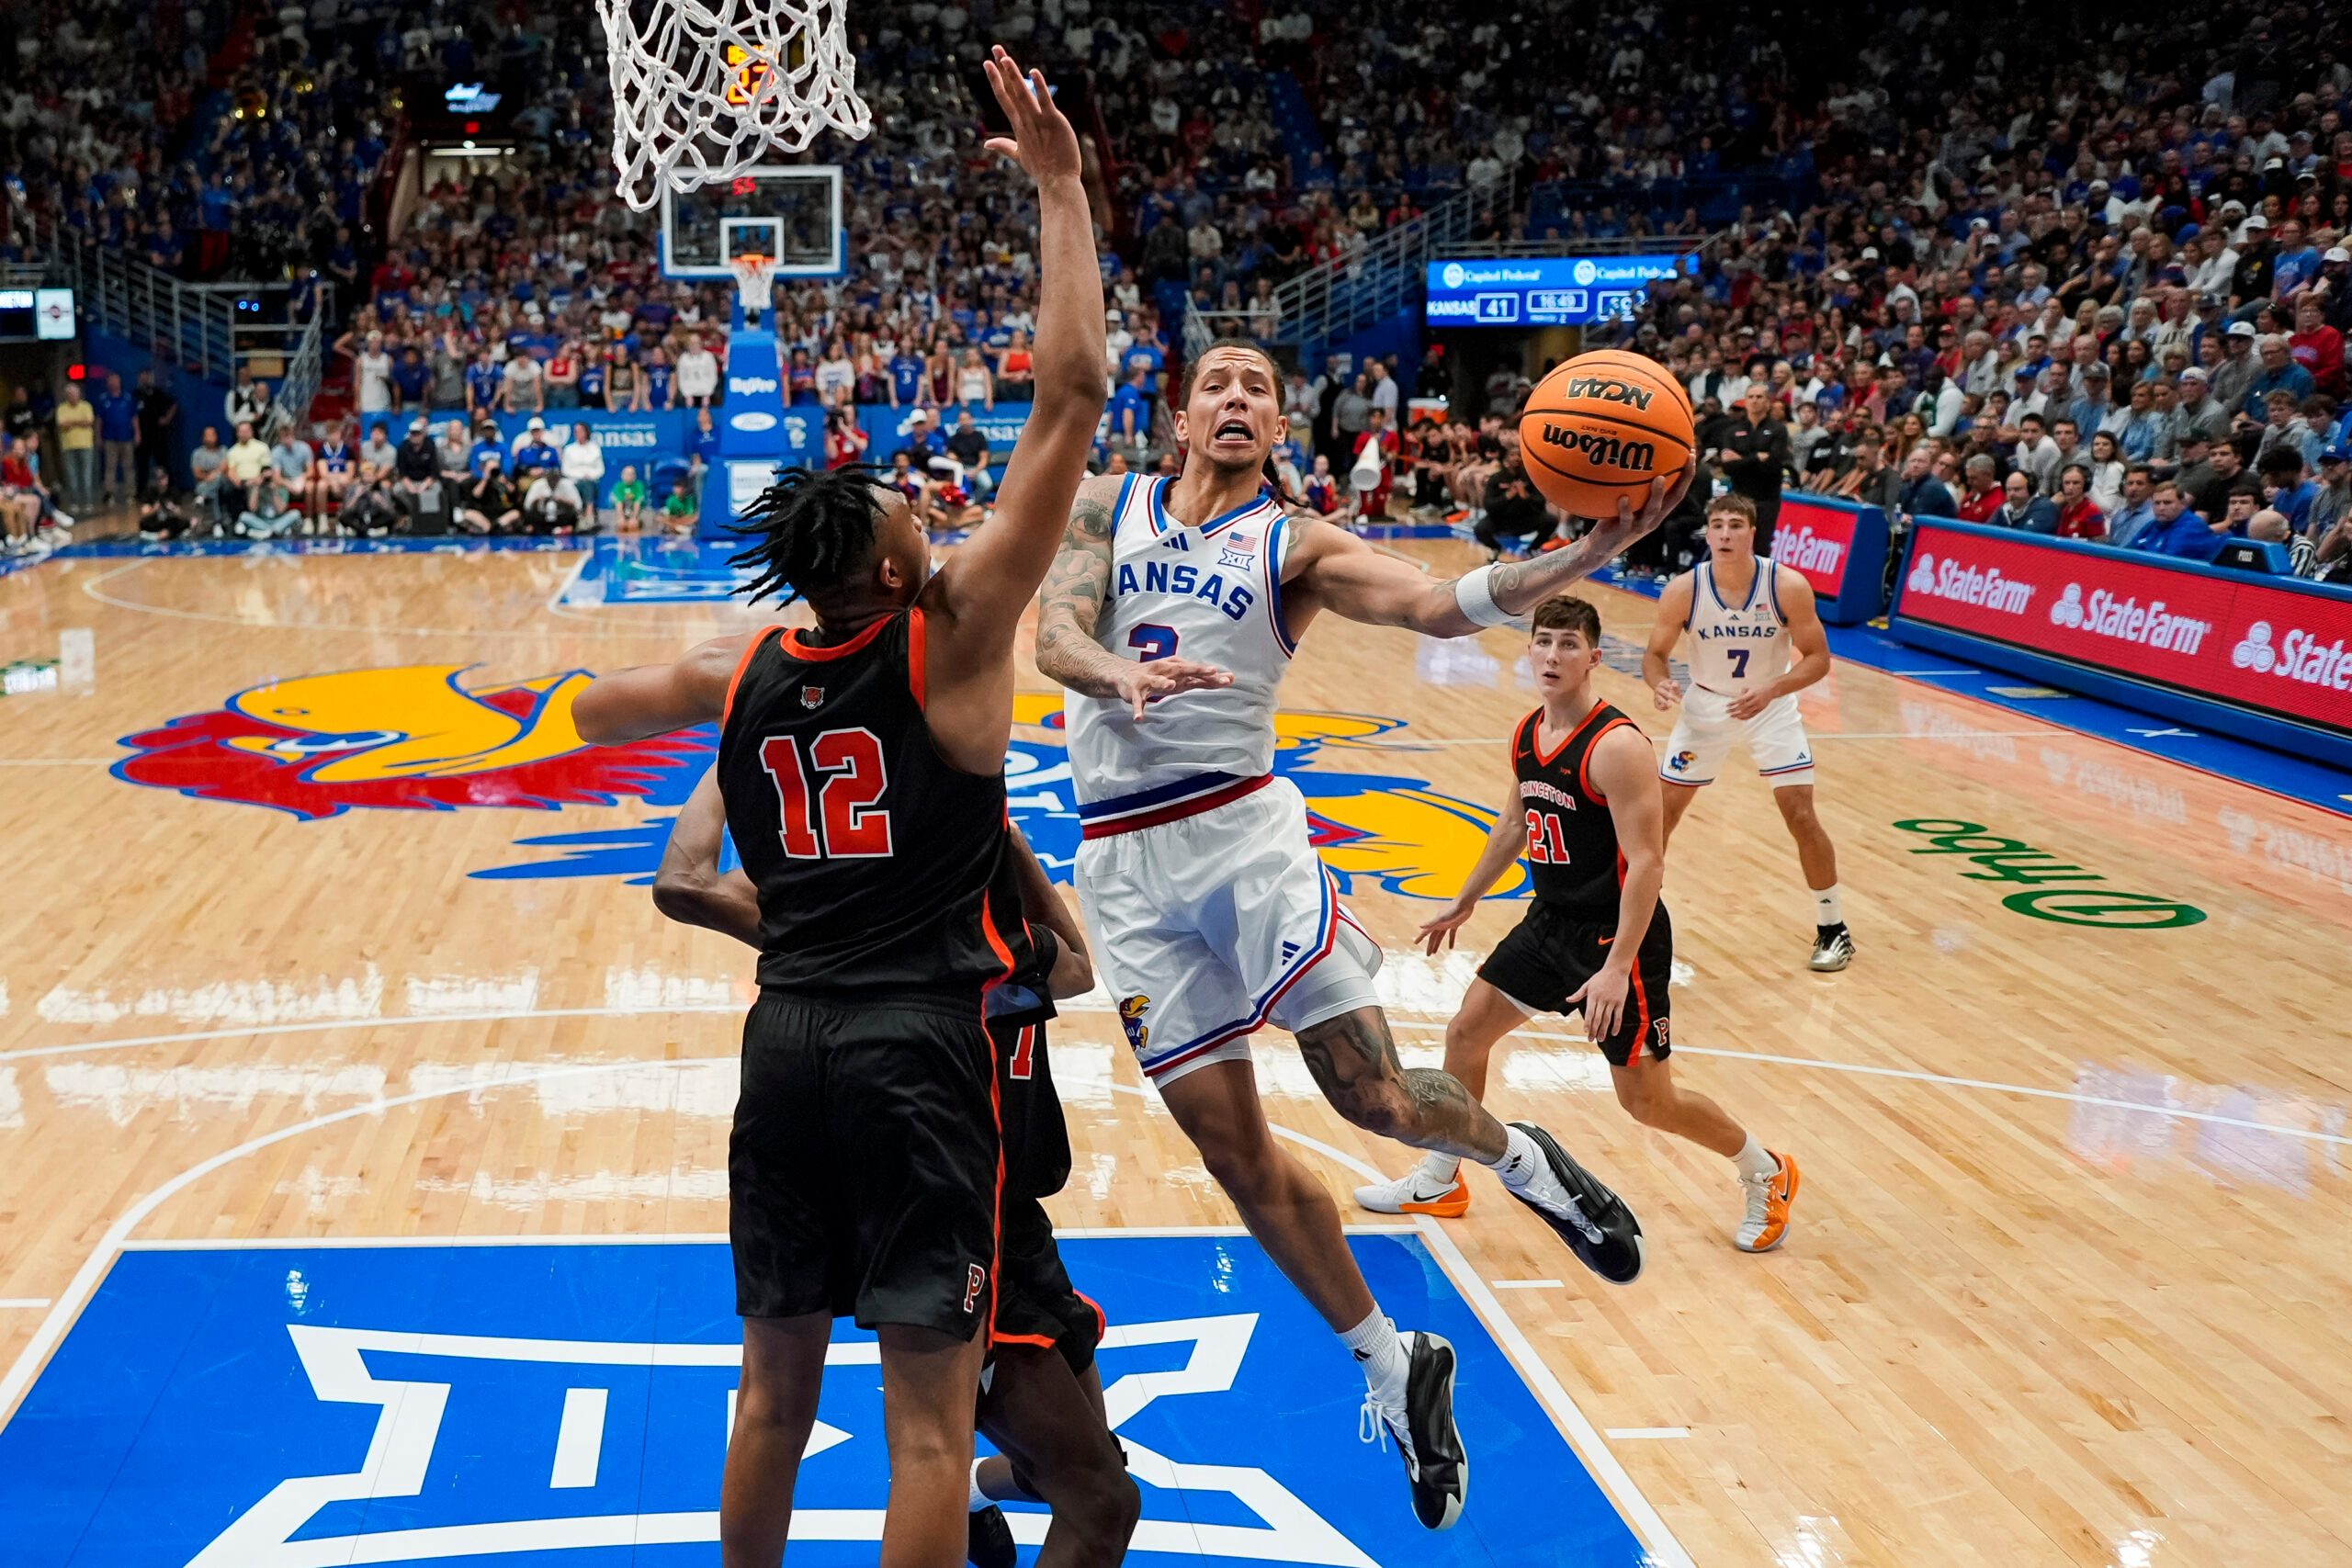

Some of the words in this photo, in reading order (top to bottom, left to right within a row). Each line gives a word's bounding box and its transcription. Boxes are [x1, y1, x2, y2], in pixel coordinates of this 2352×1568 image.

[1486, 299, 1509, 317] 41
[1566, 378, 1655, 412] NCAA
[589, 431, 658, 447] ansas
[1543, 423, 1655, 471] Wilson
[1770, 524, 1842, 575] ateFarm
[1108, 561, 1255, 622] ANSAS
[1698, 626, 1777, 640] KANSAS
[1727, 649, 1750, 678] 7
[2273, 628, 2352, 691] State
[759, 727, 894, 859] 12
[1525, 808, 1571, 864] 21
[1653, 1017, 1669, 1046] P
[964, 1263, 986, 1314] P
